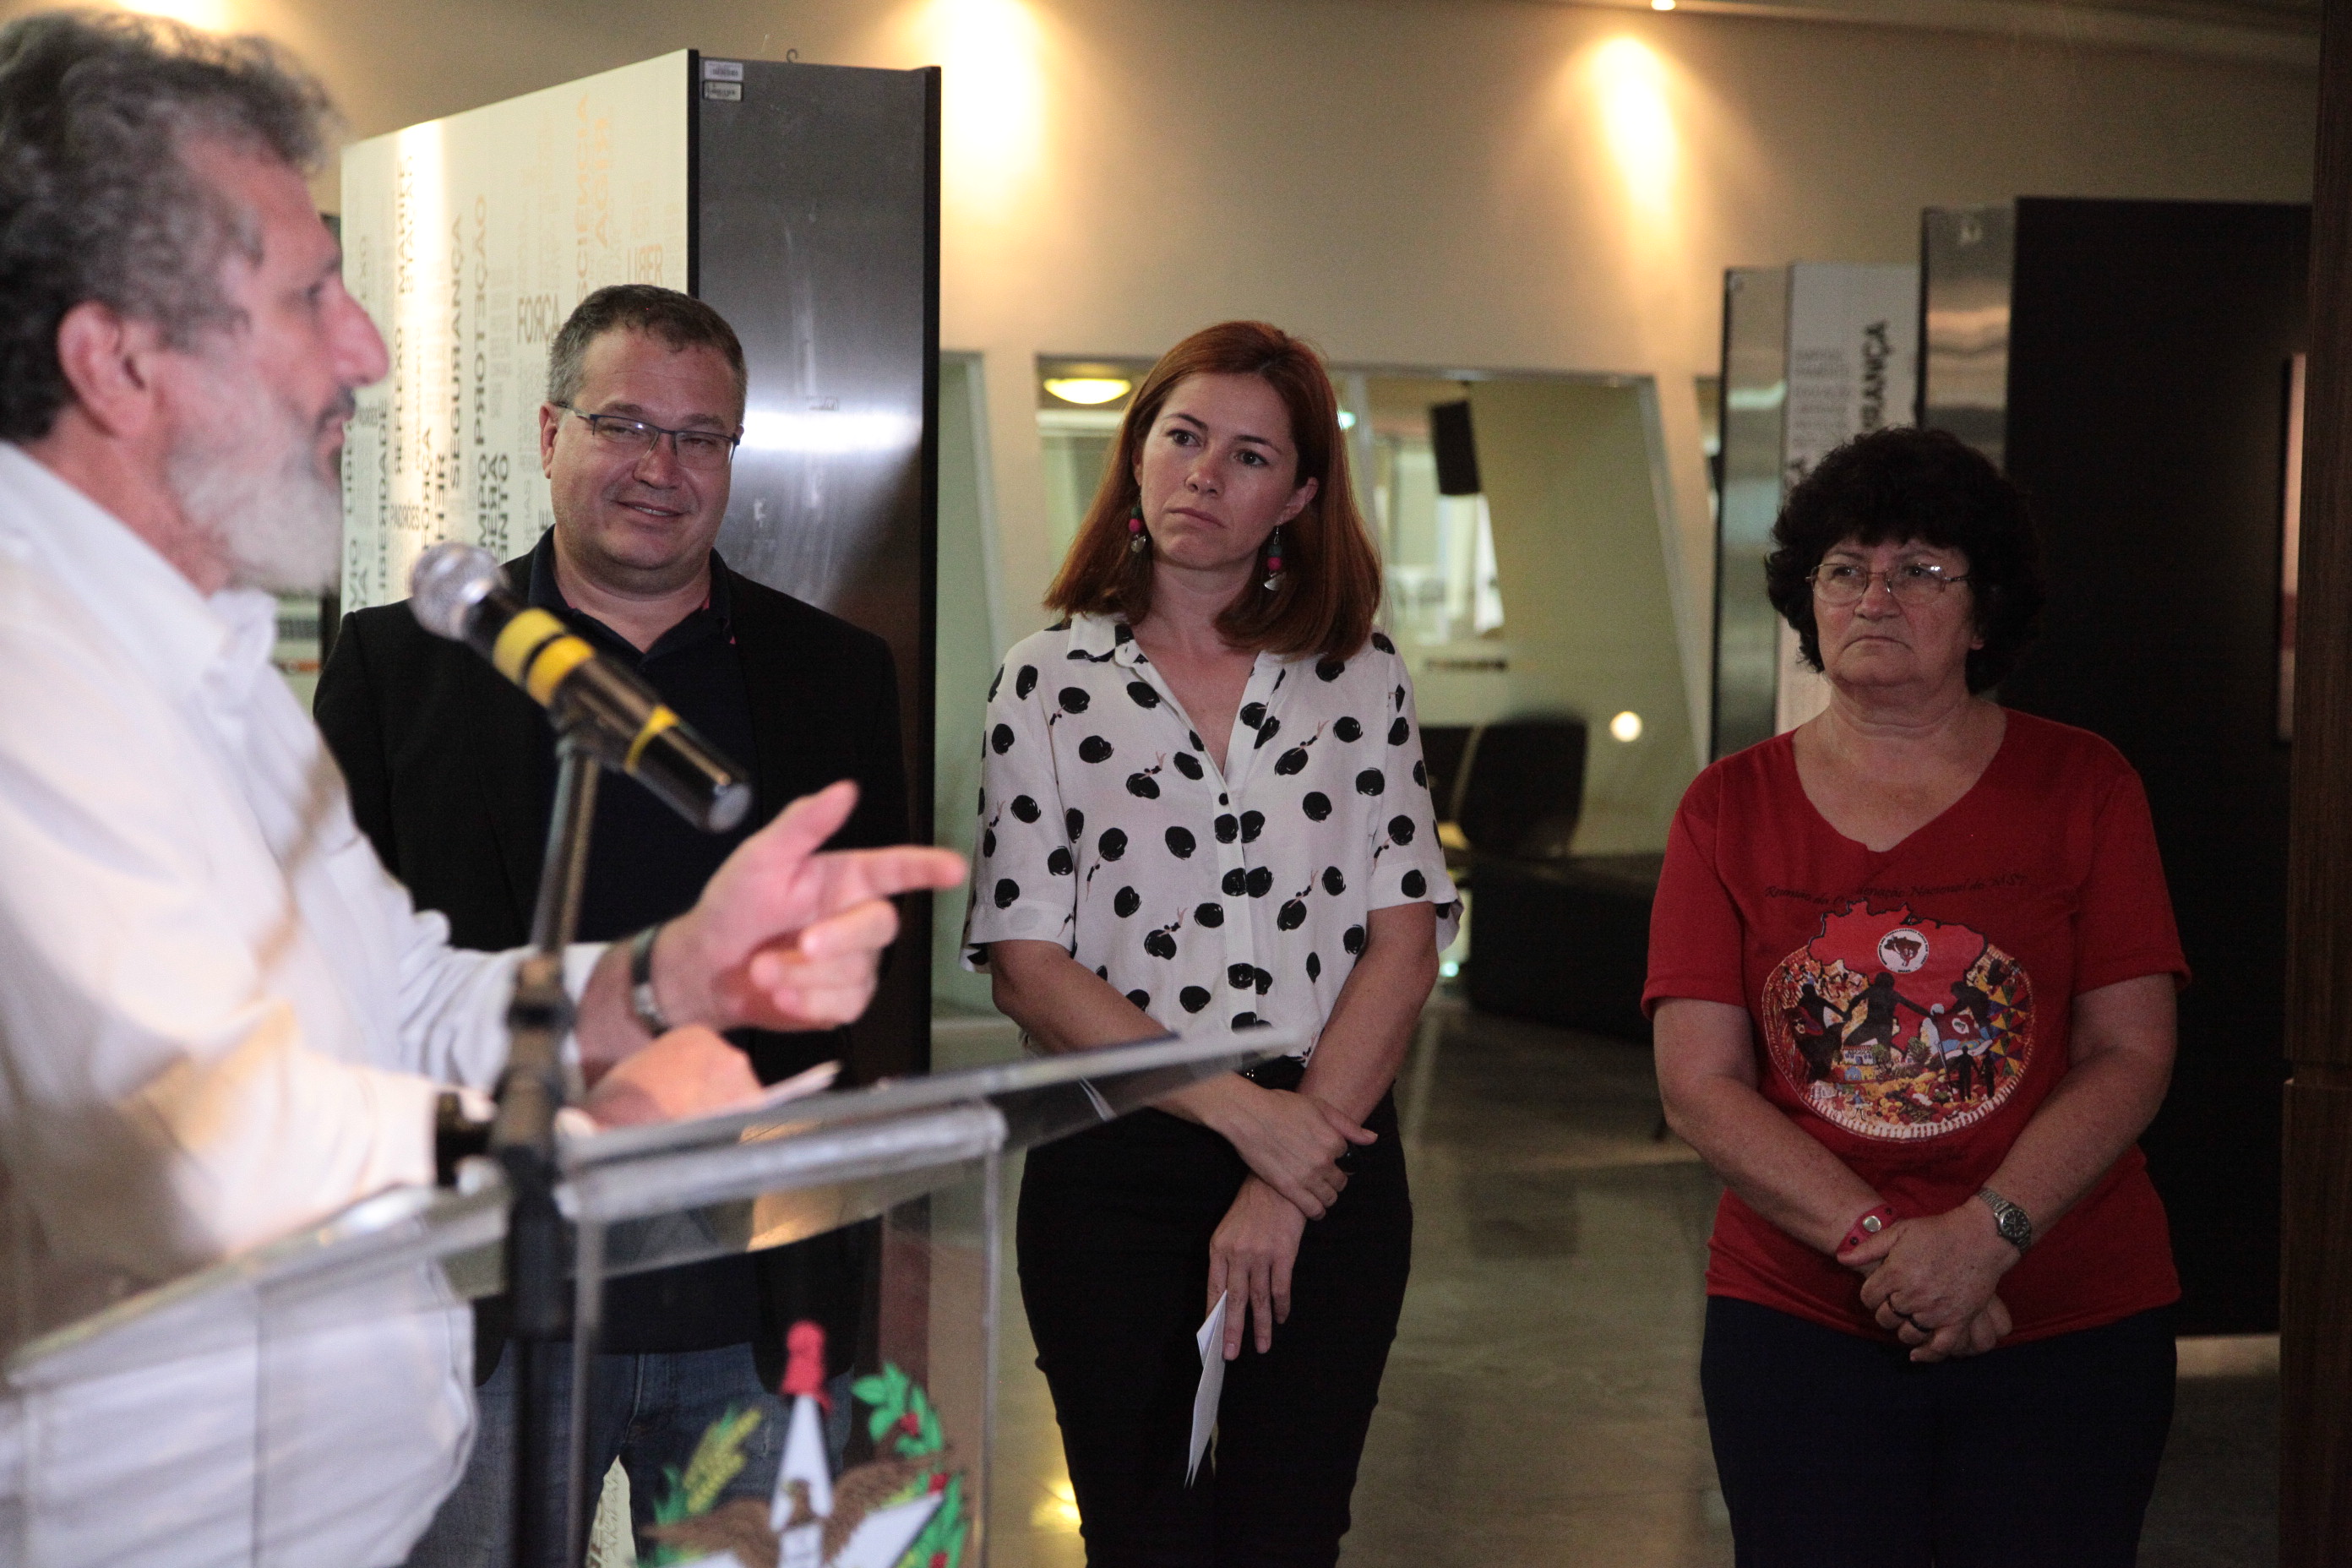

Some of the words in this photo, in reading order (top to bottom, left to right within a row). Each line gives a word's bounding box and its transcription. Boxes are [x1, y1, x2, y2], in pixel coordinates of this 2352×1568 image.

[449, 213, 463, 489] SEGURANÇA
[473, 194, 487, 447] PROTEÇÃO
[517, 293, 560, 348] FORÇA
[394, 327, 402, 475] REFLEXO
[422, 427, 433, 550] FORÇA
[477, 453, 487, 549] MPO
